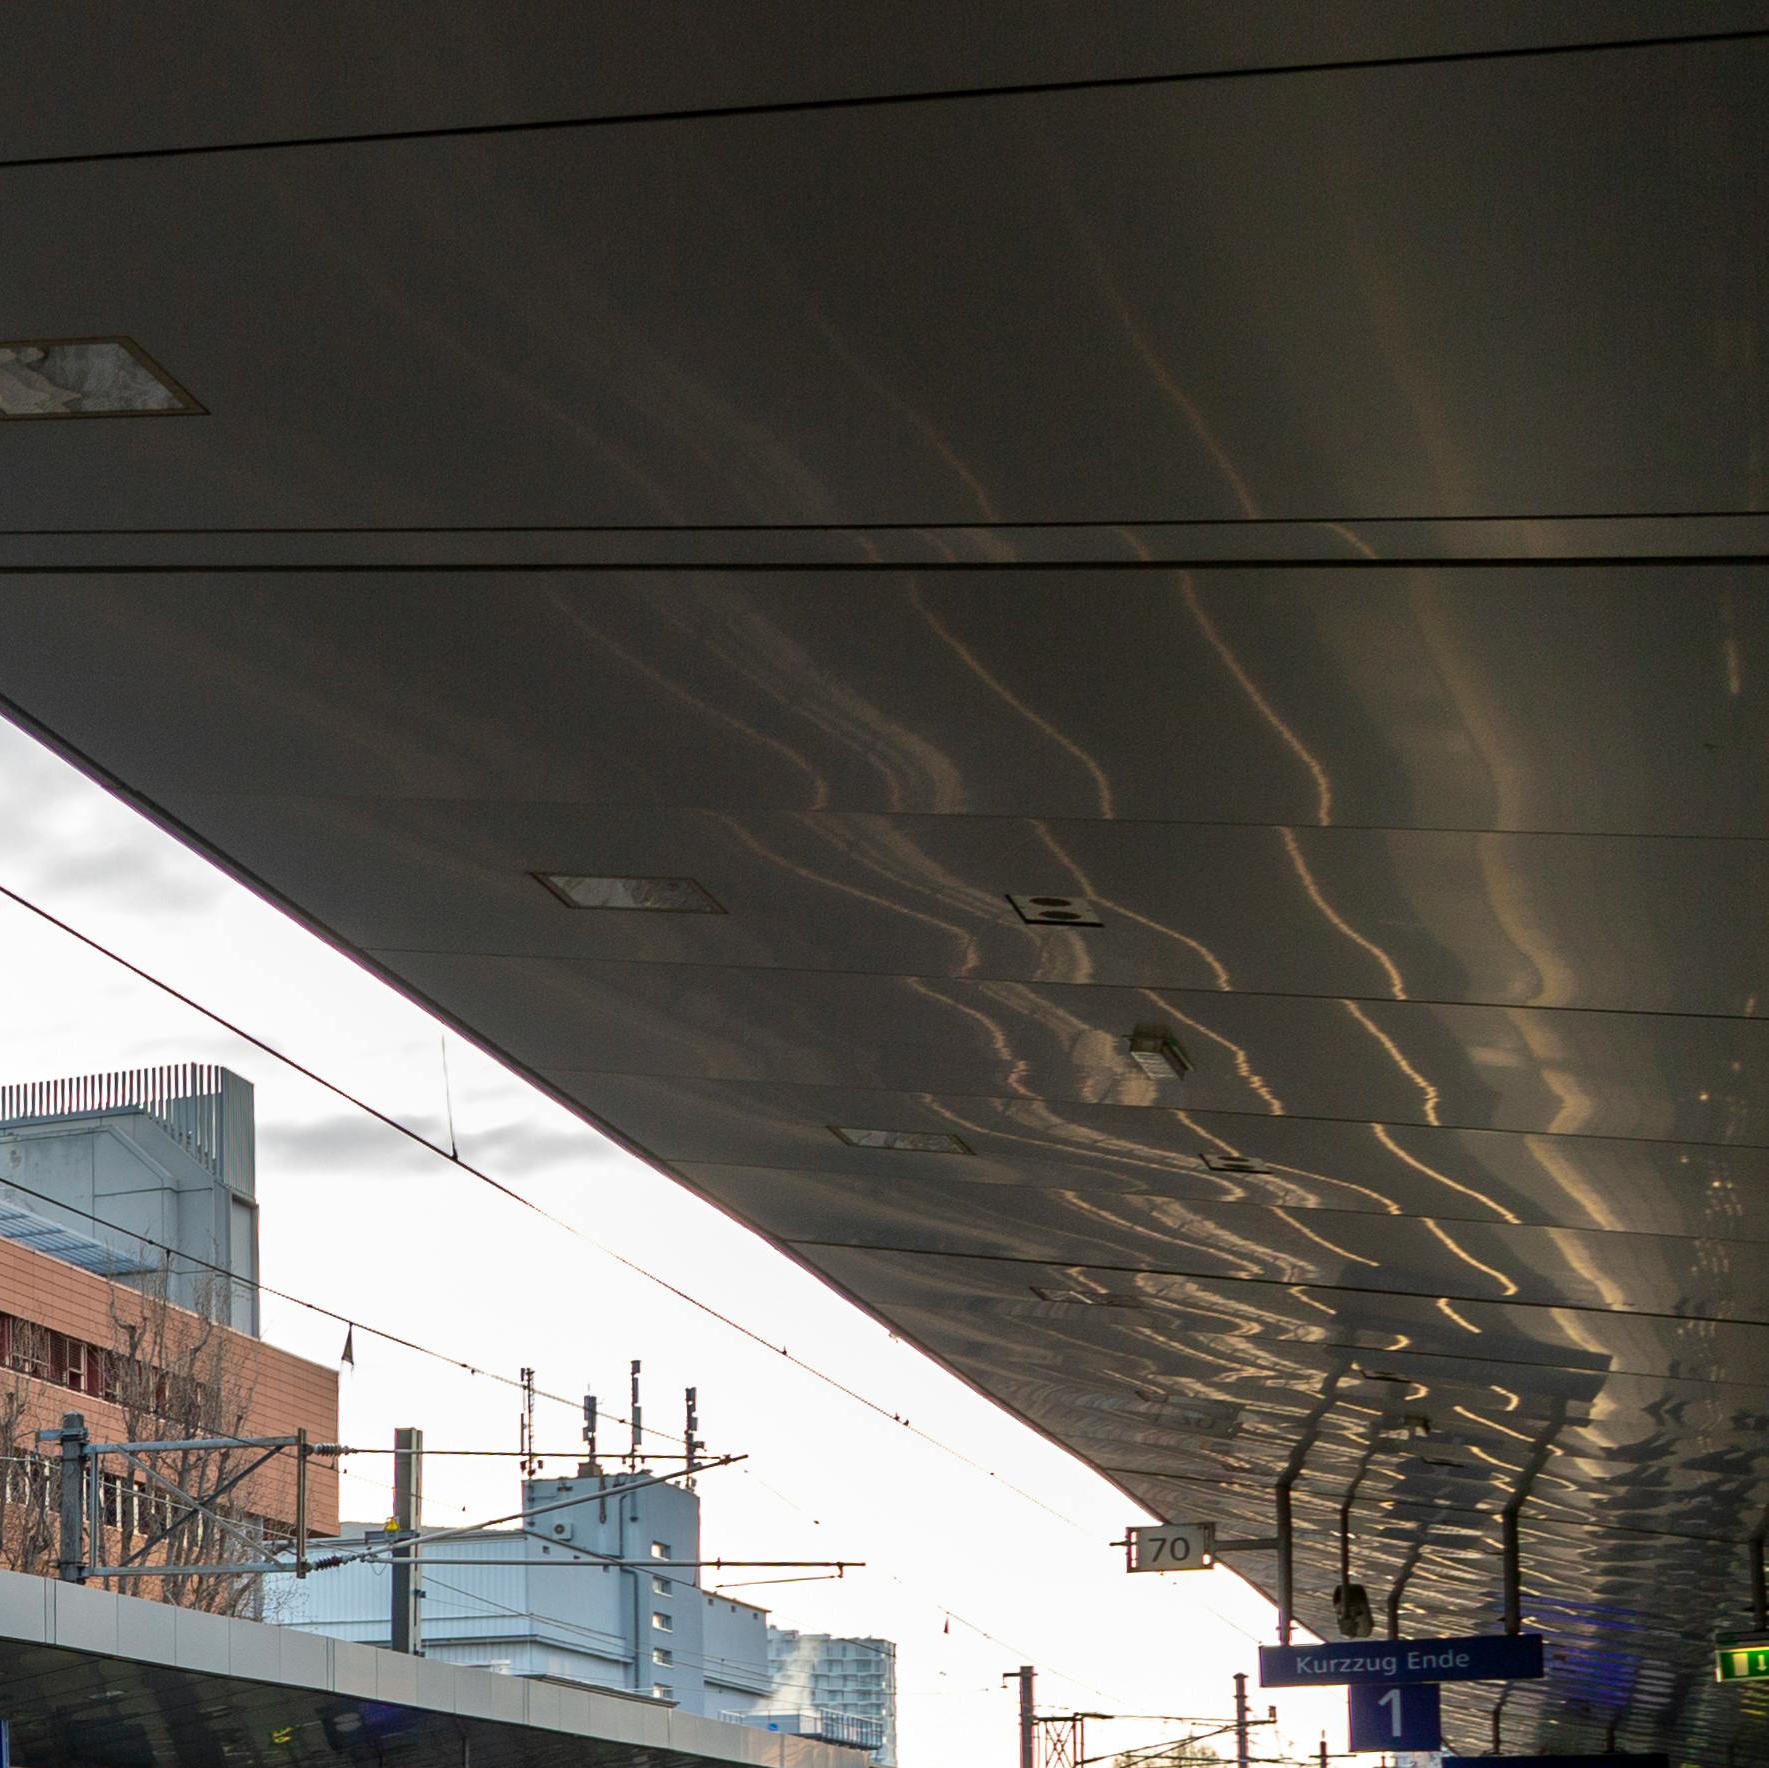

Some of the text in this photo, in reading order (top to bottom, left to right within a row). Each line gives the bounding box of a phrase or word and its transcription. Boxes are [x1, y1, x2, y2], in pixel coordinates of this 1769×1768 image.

[1148, 1537, 1190, 1563] 70
[1295, 1649, 1471, 1677] Kurzzug Ende
[1378, 1688, 1401, 1738] 1
